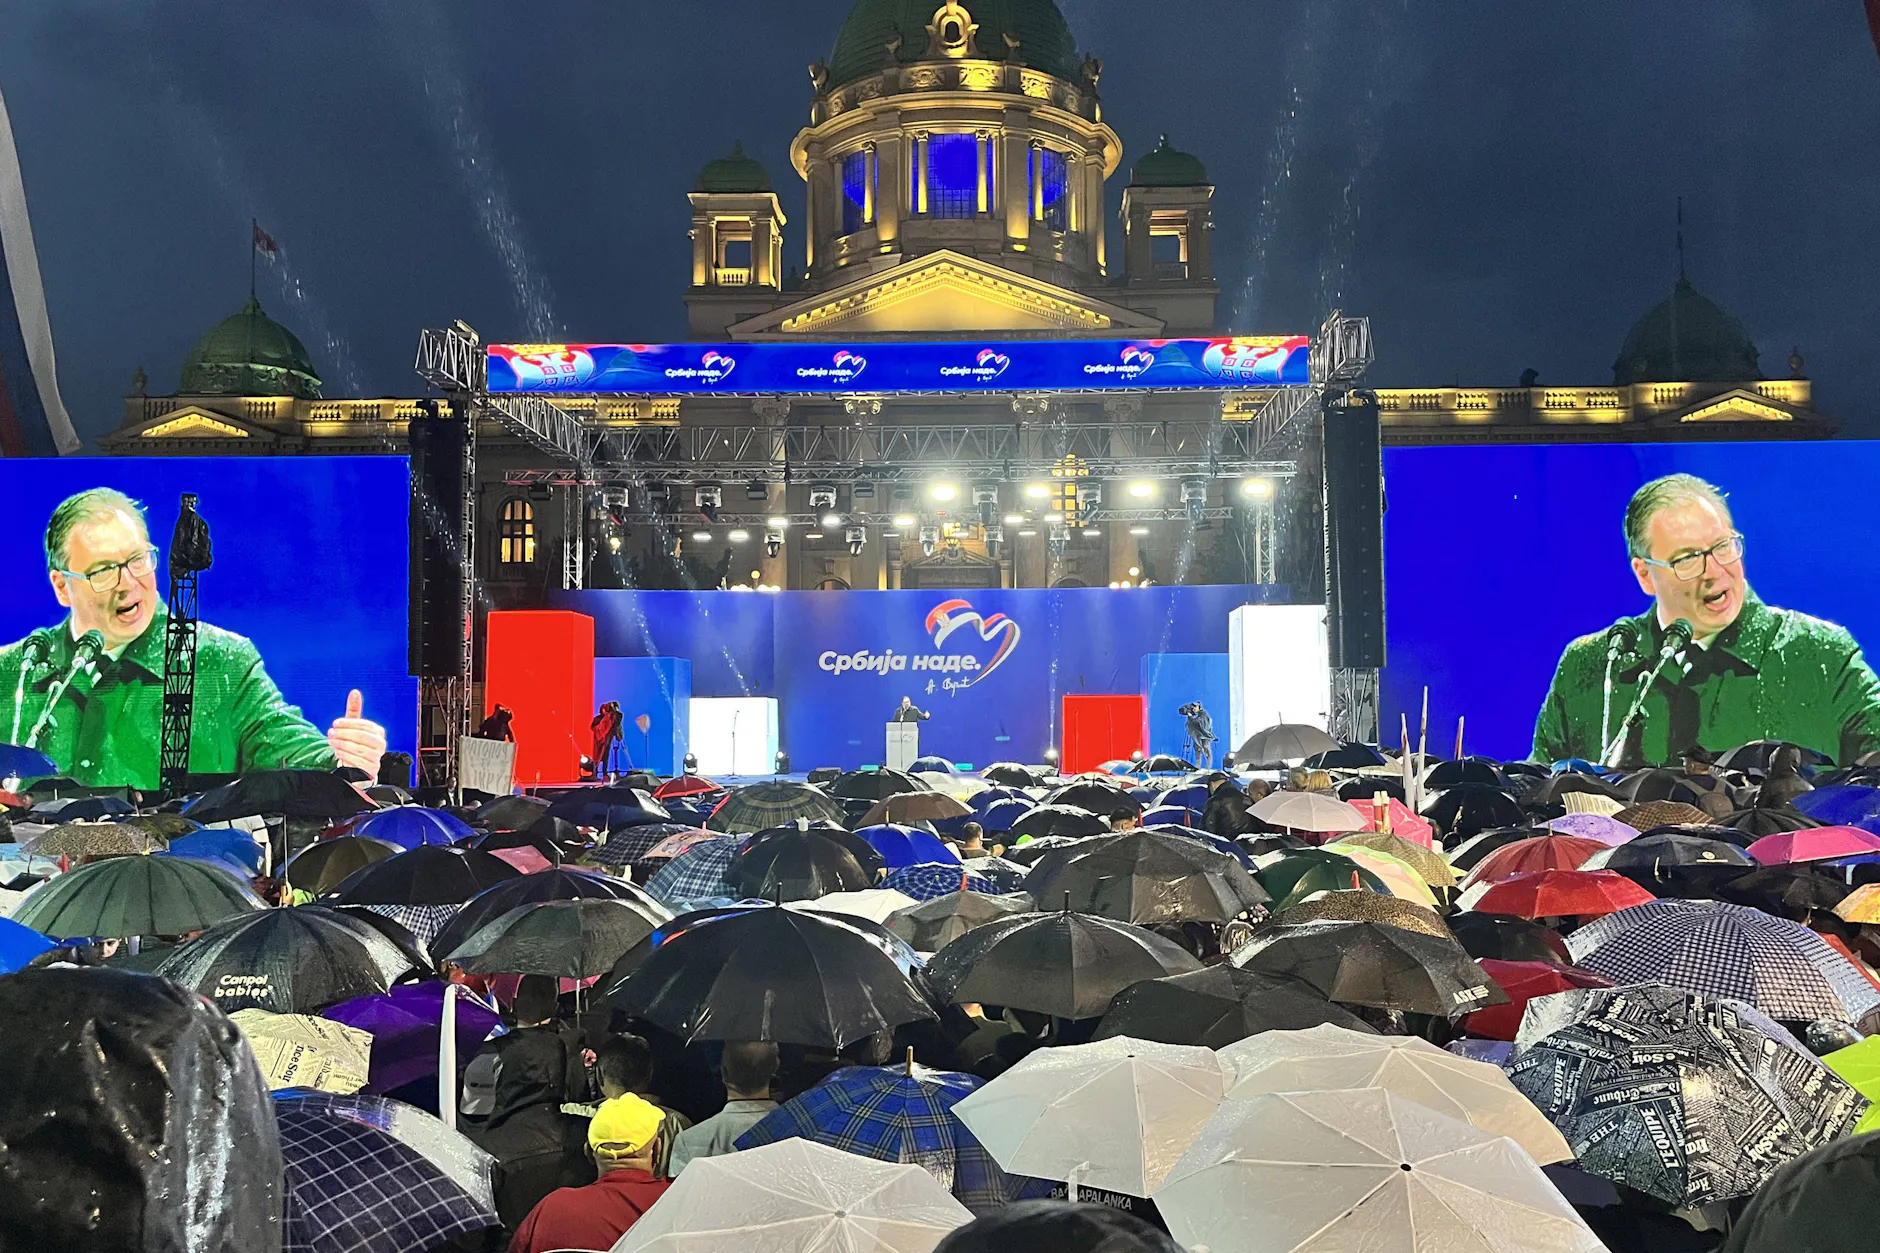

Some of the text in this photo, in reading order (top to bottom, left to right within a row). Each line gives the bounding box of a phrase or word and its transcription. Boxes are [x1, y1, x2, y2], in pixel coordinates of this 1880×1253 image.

[665, 367, 696, 378] Србија
[797, 367, 828, 378] Србија
[940, 366, 971, 376] Србија
[1084, 365, 1115, 374] Србија
[818, 649, 981, 675] Србија наде.
[220, 974, 268, 986] Canpol
[214, 985, 269, 998] babies
[1514, 1057, 1538, 1070] THE
[1550, 1057, 1566, 1112] L'EQUIPE
[1593, 1087, 1640, 1105] Tribune
[1589, 1120, 1618, 1143] THE
[1640, 1107, 1679, 1169] L'EQUIPE
